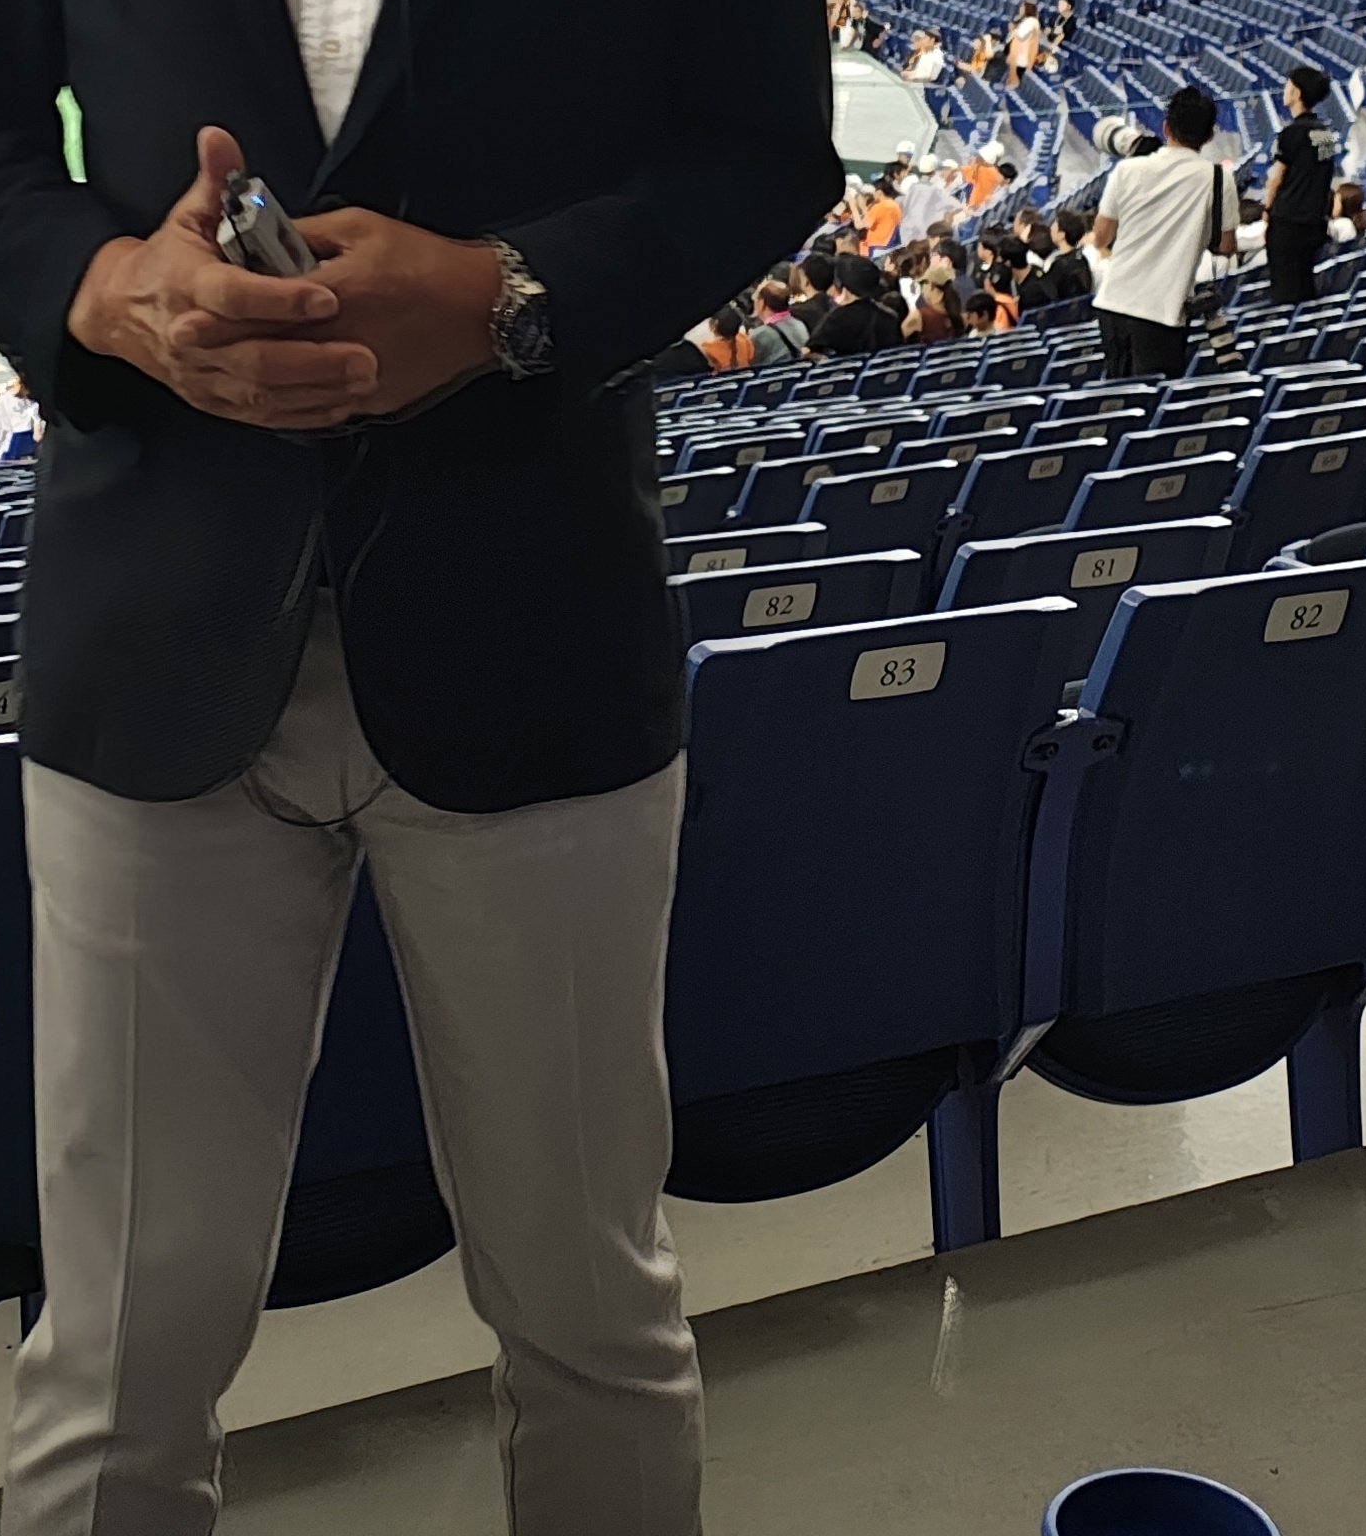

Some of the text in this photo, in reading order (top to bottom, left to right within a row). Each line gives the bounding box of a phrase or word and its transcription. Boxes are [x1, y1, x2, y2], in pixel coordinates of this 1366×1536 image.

[1091, 559, 1116, 579] 81
[765, 594, 795, 618] 82
[1290, 604, 1323, 629] 82
[879, 658, 917, 687] 83
